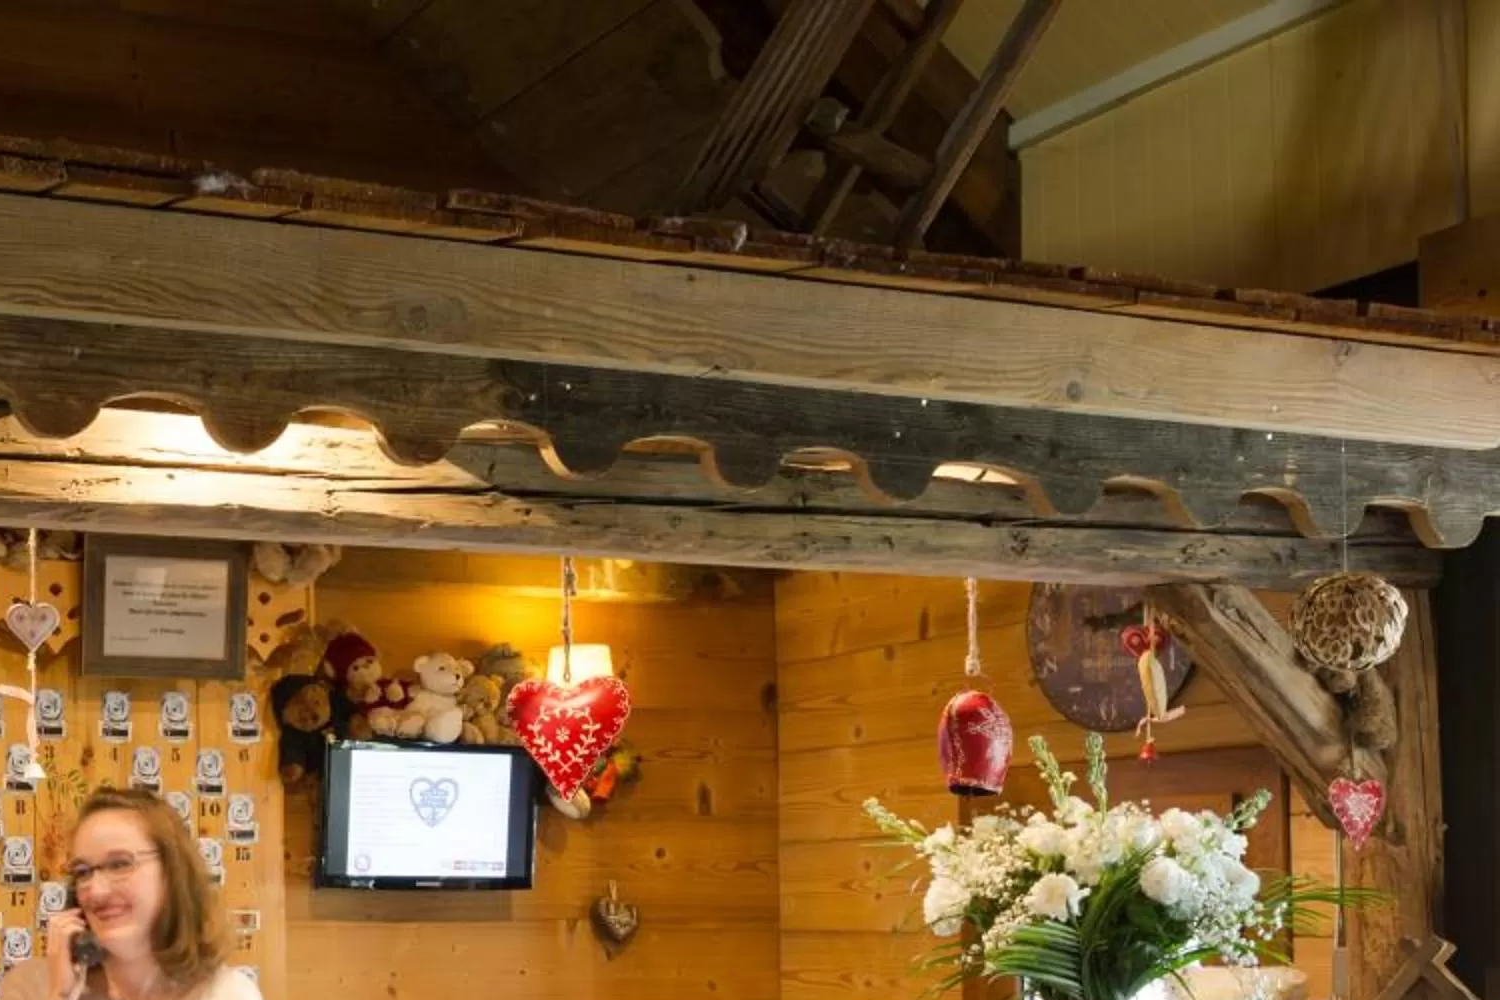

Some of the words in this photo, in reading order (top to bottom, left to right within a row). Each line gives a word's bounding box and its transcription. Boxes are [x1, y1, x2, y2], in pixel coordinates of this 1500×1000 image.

[170, 747, 182, 763] 5
[14, 799, 26, 815] 8
[200, 802, 221, 817] 10
[235, 847, 251, 861] 15
[10, 890, 28, 907] 17
